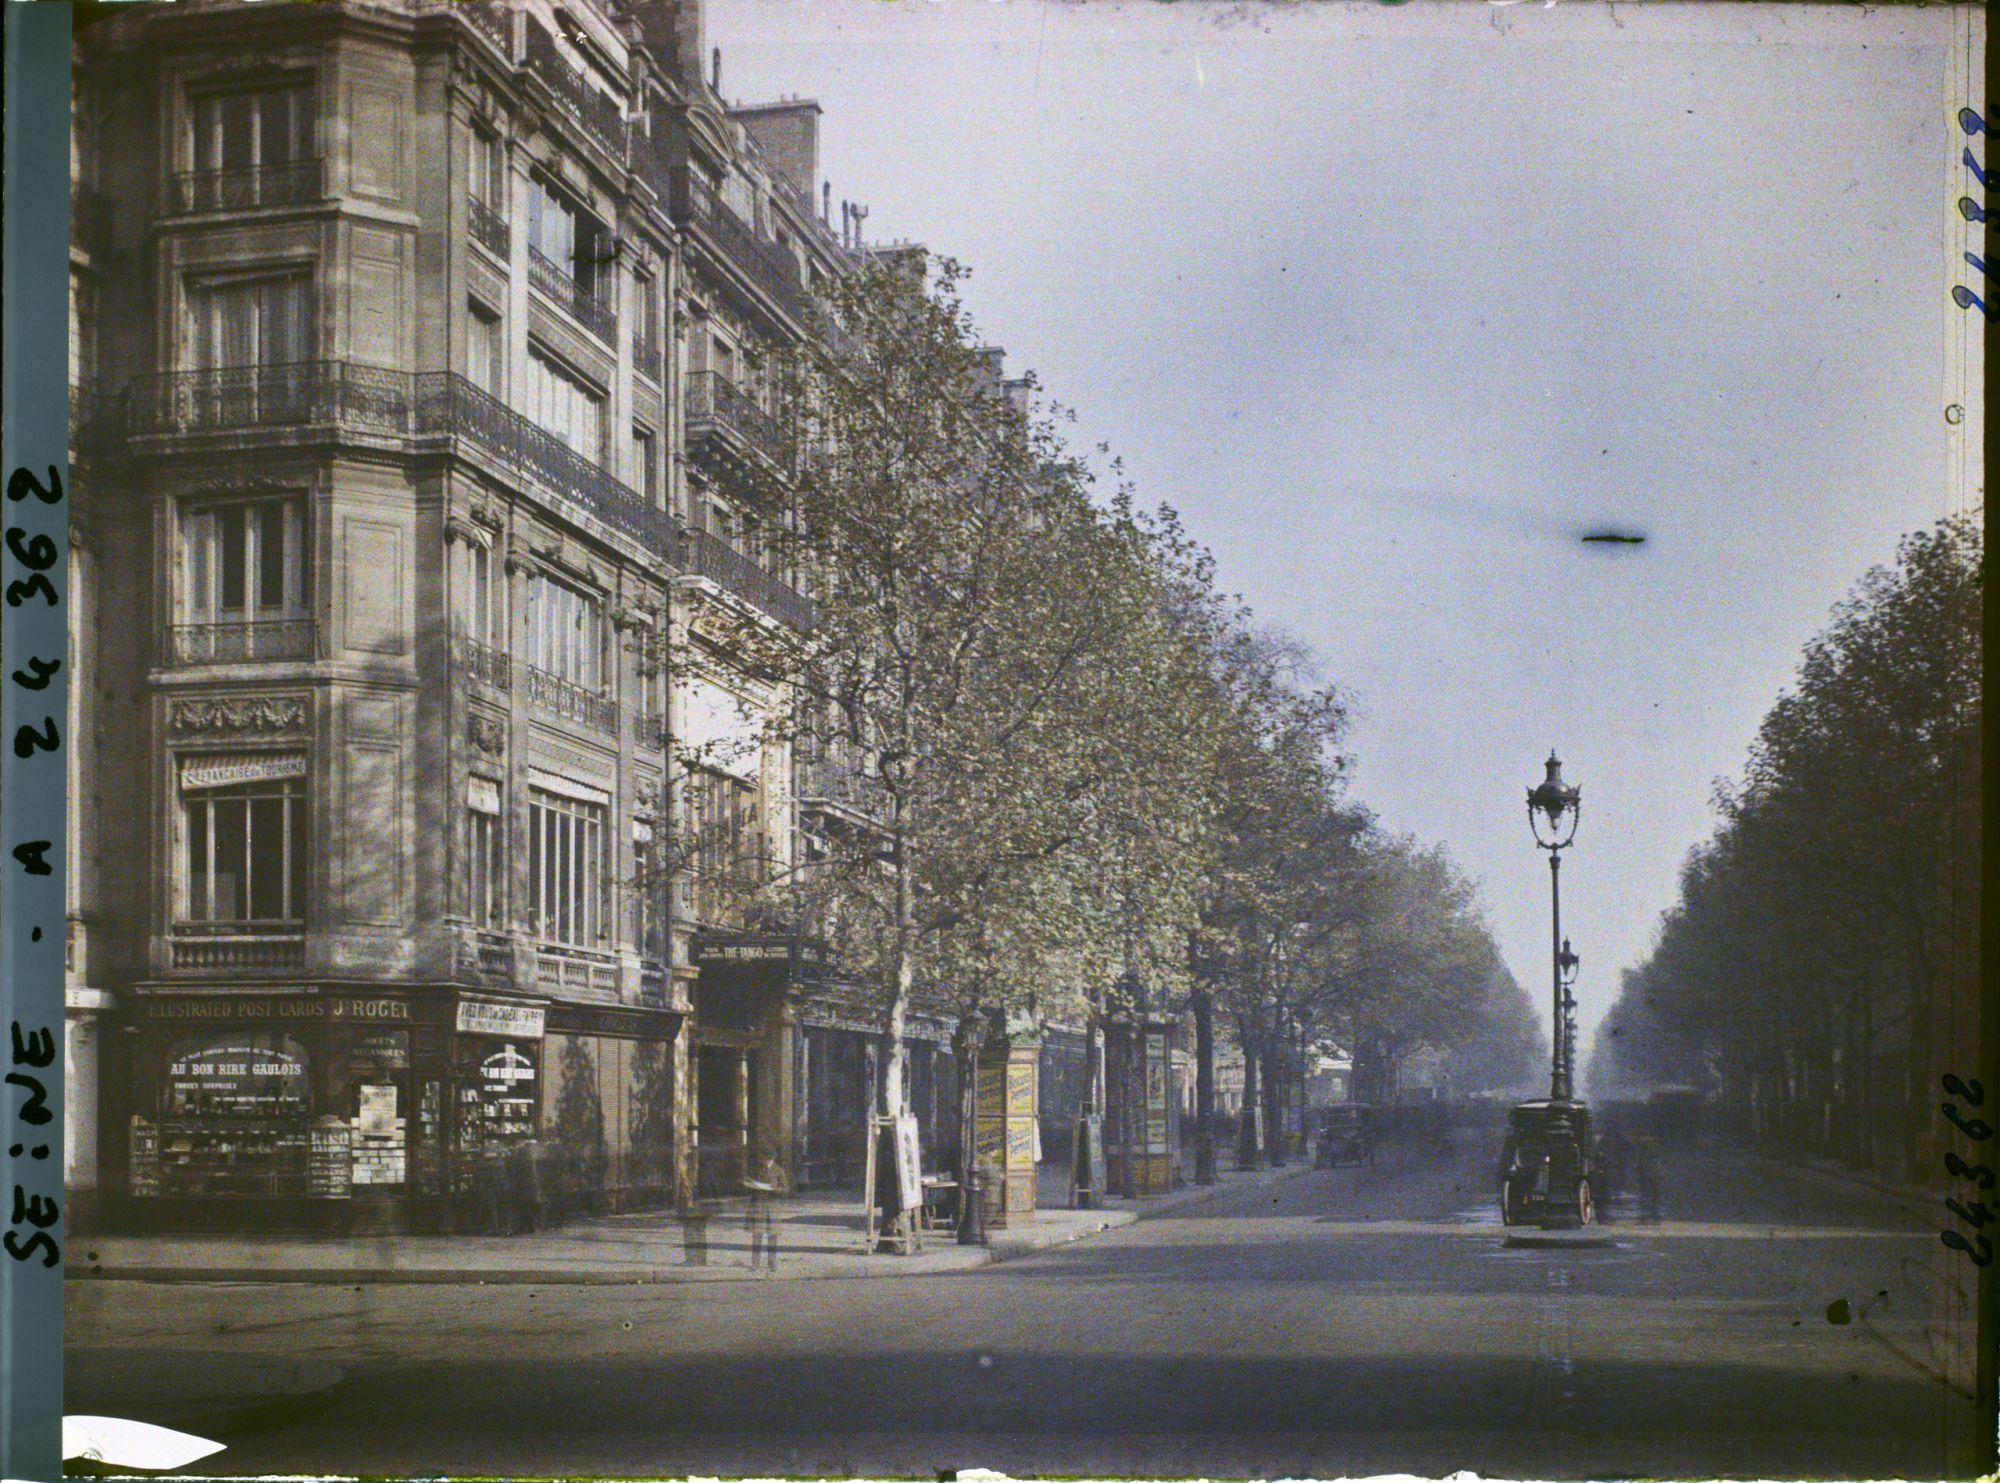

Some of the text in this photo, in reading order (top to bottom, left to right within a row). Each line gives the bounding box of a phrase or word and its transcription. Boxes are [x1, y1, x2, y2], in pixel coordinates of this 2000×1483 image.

[13, 841, 53, 876] A
[147, 1001, 325, 1018] ILLUSTRATED POST CARDS
[352, 1000, 410, 1018] ROGET
[171, 1063, 186, 1075] AU
[191, 1063, 214, 1075] BON
[252, 1063, 301, 1075] GAULOIS
[1941, 1073, 1995, 1267] 24362
